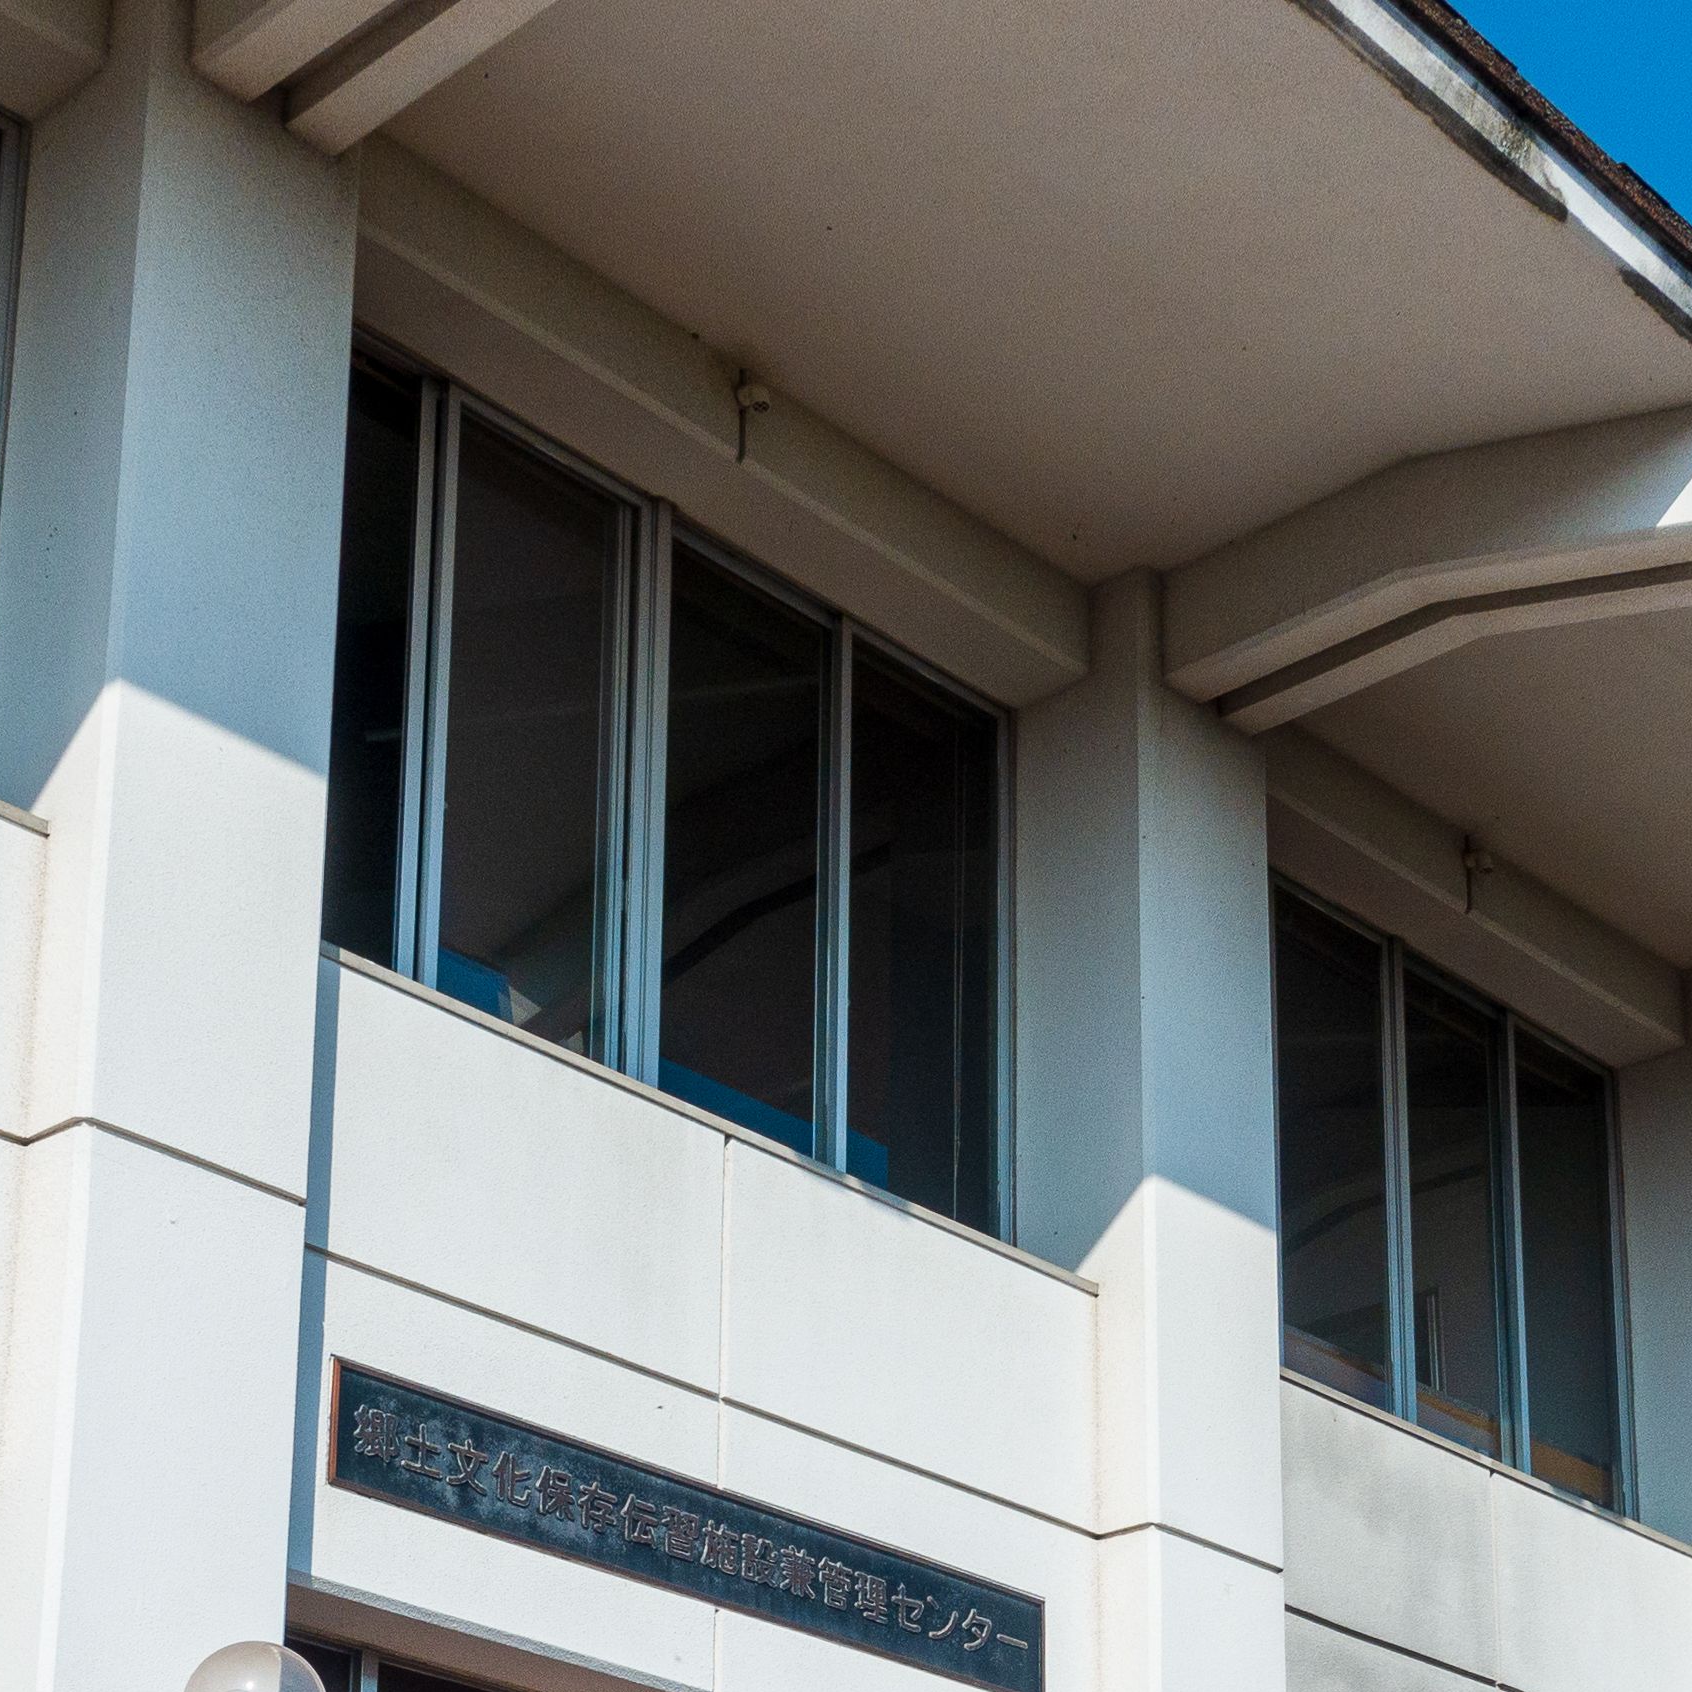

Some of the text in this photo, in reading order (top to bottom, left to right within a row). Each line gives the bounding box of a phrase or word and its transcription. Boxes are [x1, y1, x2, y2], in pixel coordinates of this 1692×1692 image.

[353, 1404, 1029, 1652] 郷土文化保存伝習施設兼管理センター
